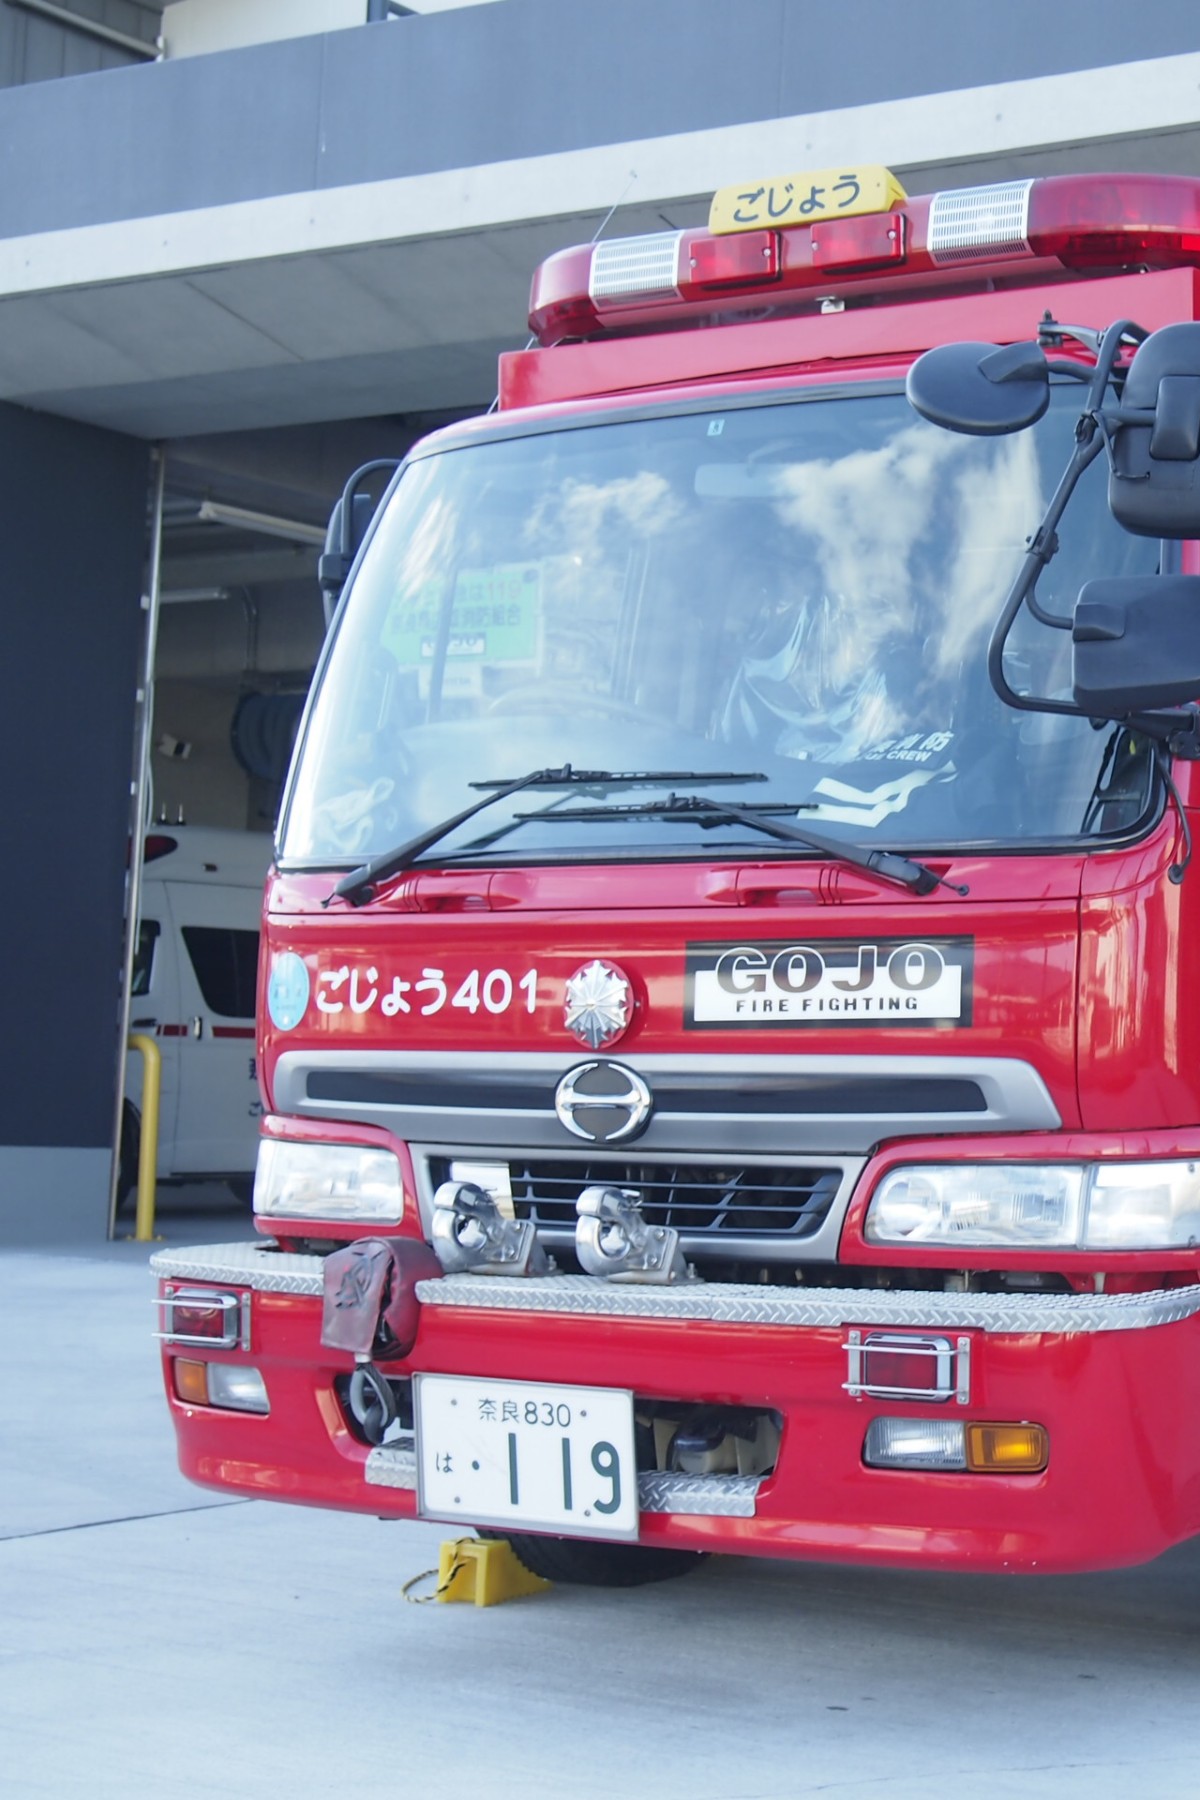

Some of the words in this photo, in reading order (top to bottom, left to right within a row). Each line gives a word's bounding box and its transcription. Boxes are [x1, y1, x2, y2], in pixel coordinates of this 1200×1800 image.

[733, 174, 861, 223] ごじょう
[886, 750, 933, 763] CREW
[715, 943, 946, 995] GOJO
[316, 965, 538, 1017] ごじょう401
[735, 998, 790, 1013] FIRE
[802, 996, 919, 1012] FIGHTING
[435, 1451, 454, 1474] は
